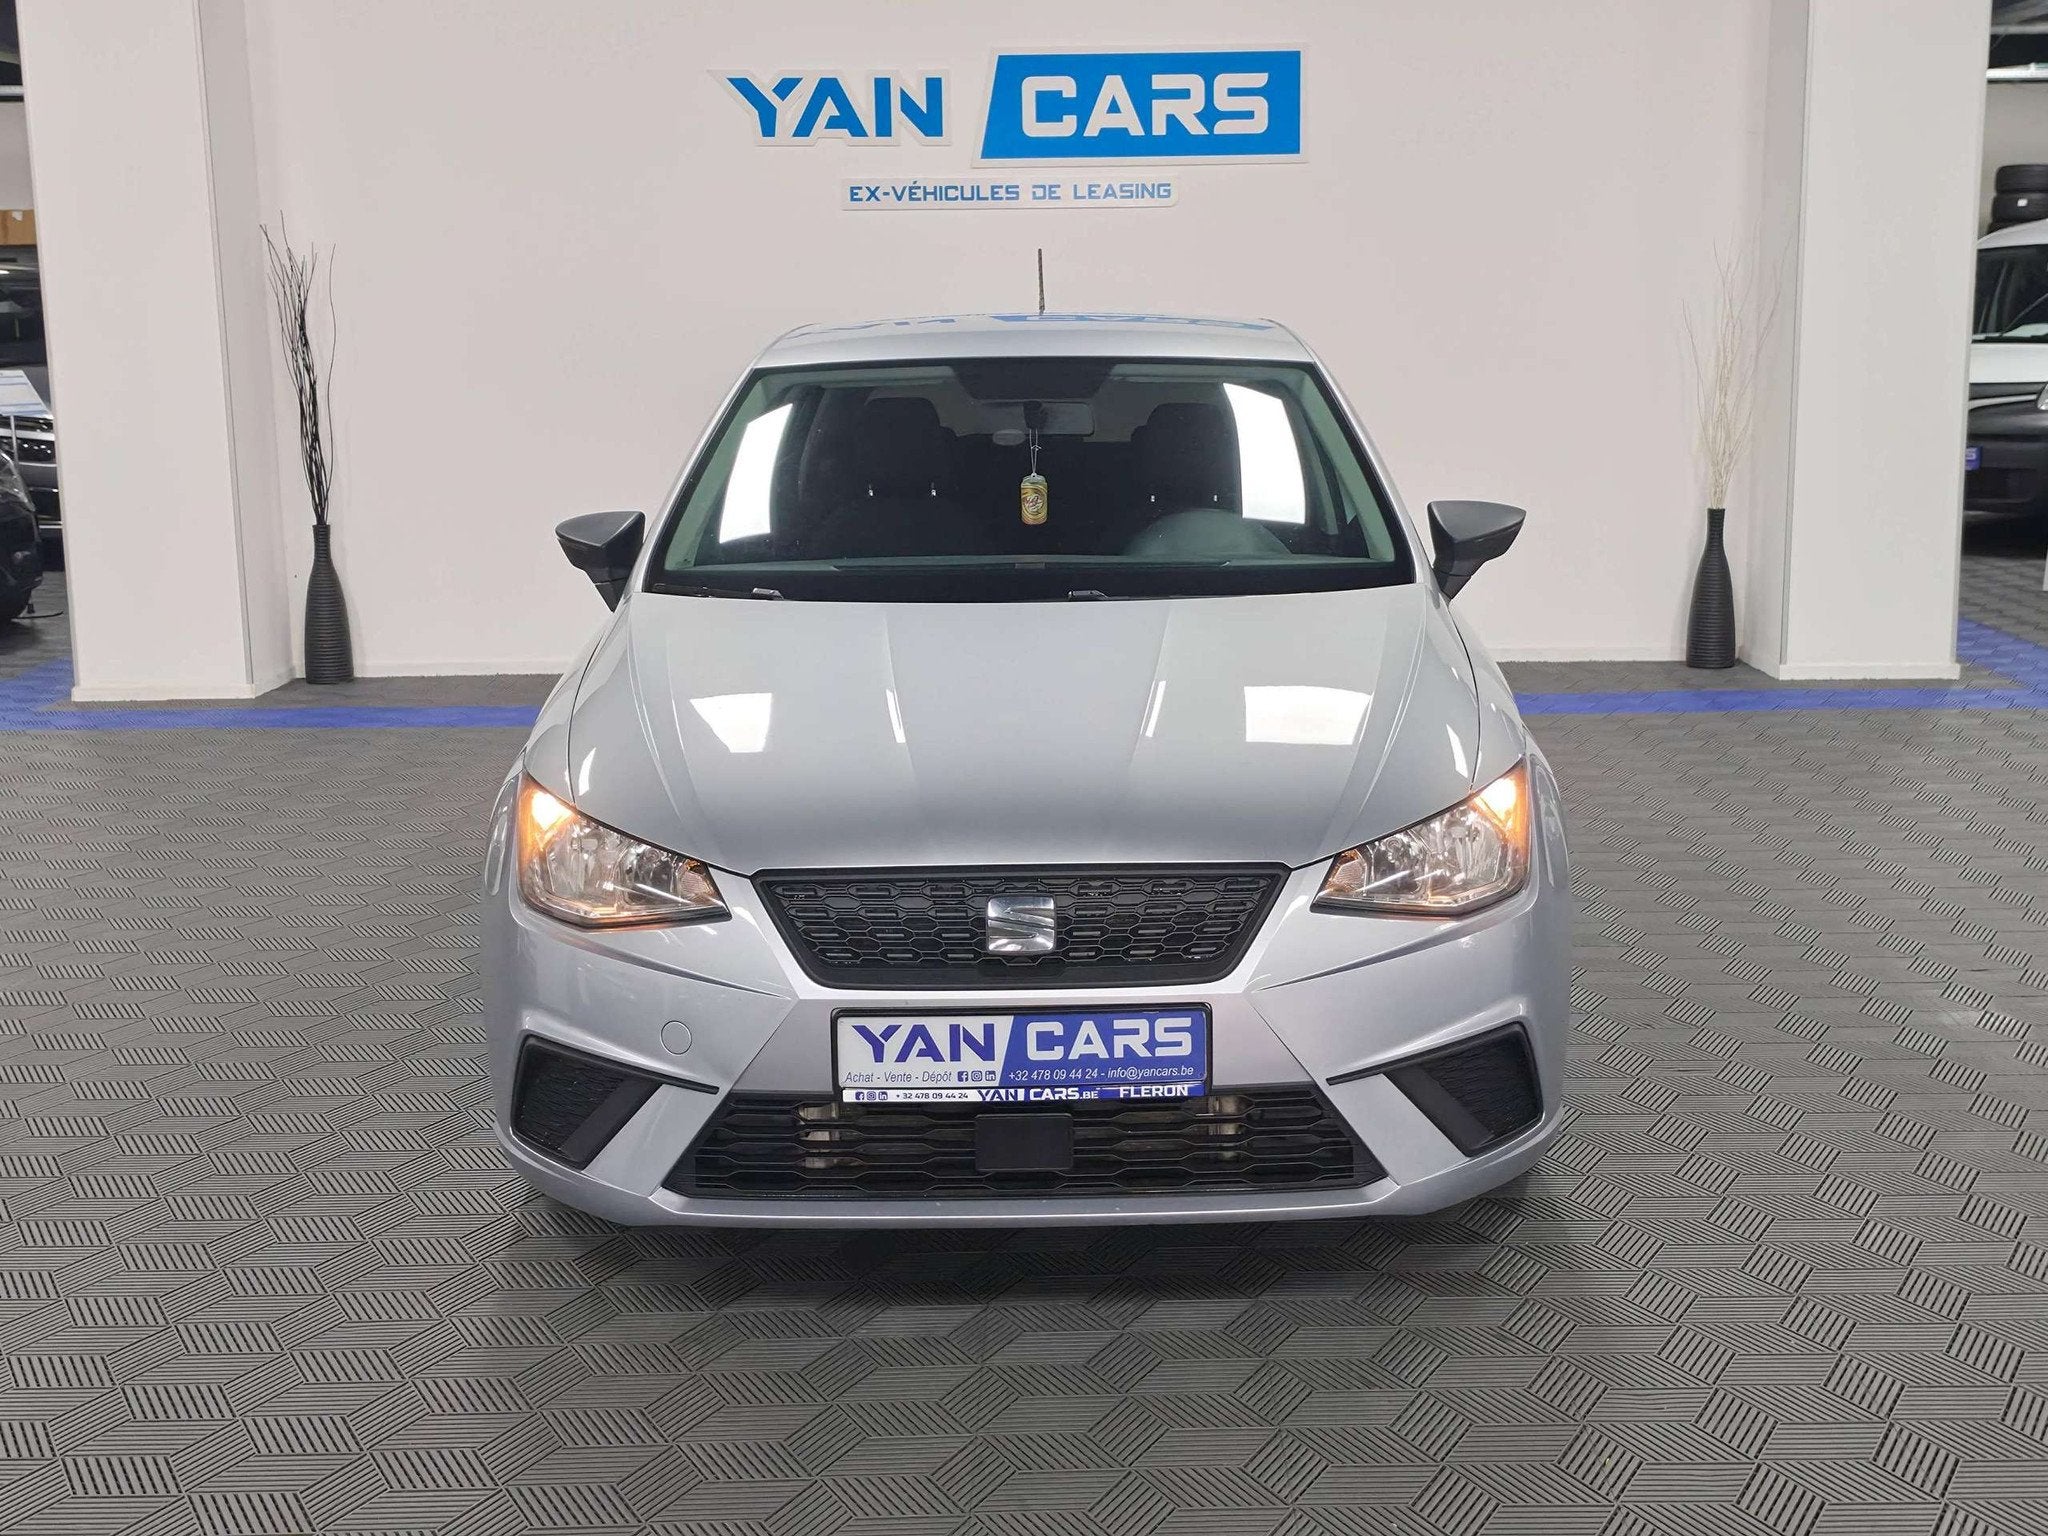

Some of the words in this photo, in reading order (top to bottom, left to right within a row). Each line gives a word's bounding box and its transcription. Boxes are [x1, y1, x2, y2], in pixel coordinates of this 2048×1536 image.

[726, 76, 943, 138] YAN
[1021, 71, 1270, 138] CARS
[849, 180, 1020, 203] EX-VÉHICULES
[1031, 184, 1062, 200] DE
[1072, 182, 1172, 200] LEASING
[852, 1023, 997, 1063] YAN
[1025, 1017, 1193, 1061] CARS
[845, 1071, 874, 1083] Achat
[884, 1070, 912, 1083] Vente
[922, 1070, 953, 1084] Dépôt
[1009, 1069, 1028, 1081] +32
[1031, 1069, 1051, 1080] 478
[1053, 1068, 1067, 1080] 09
[1069, 1068, 1083, 1079] 44
[1085, 1067, 1099, 1079] 24
[1107, 1065, 1194, 1080] info@yancars.be
[977, 1090, 1019, 1101] YAN
[1119, 1085, 1188, 1098] FLERON
